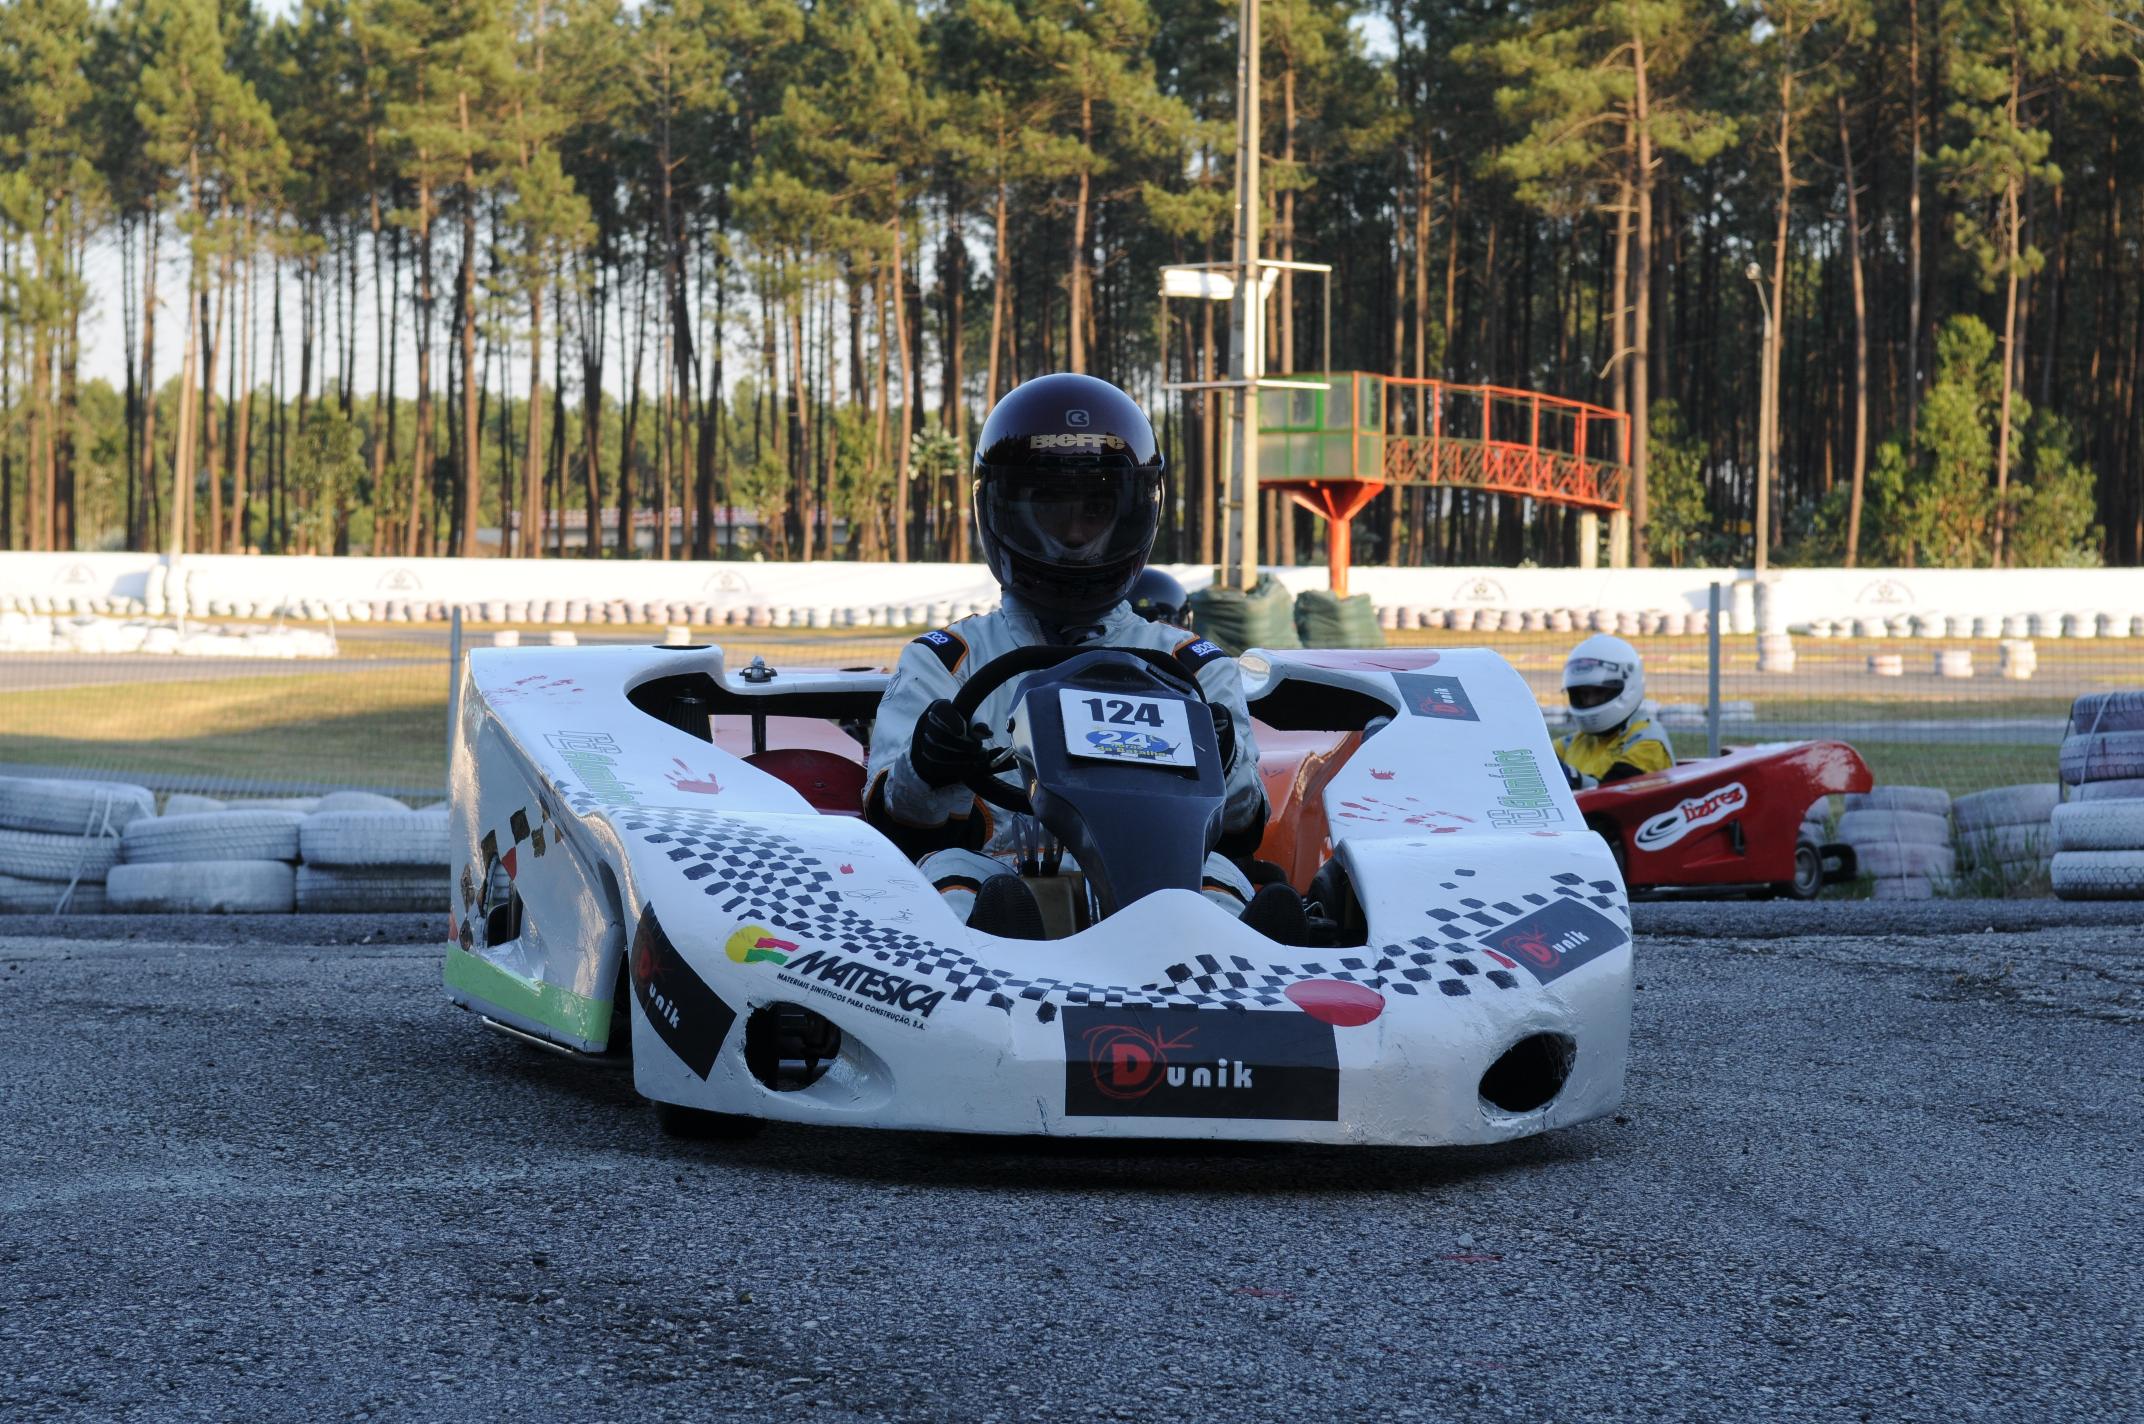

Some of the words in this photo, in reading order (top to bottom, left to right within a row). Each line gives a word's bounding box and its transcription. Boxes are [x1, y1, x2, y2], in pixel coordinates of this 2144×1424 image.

[1081, 698, 1164, 727] 124
[1098, 730, 1151, 748] 24
[777, 973, 810, 991] MATERIAIS
[810, 985, 846, 1003] SINTÉTICOS
[848, 998, 864, 1009] PARA
[913, 1020, 926, 1031] S.A.
[784, 950, 947, 1018] MATESICA
[1112, 1043, 1253, 1088] Dunik
